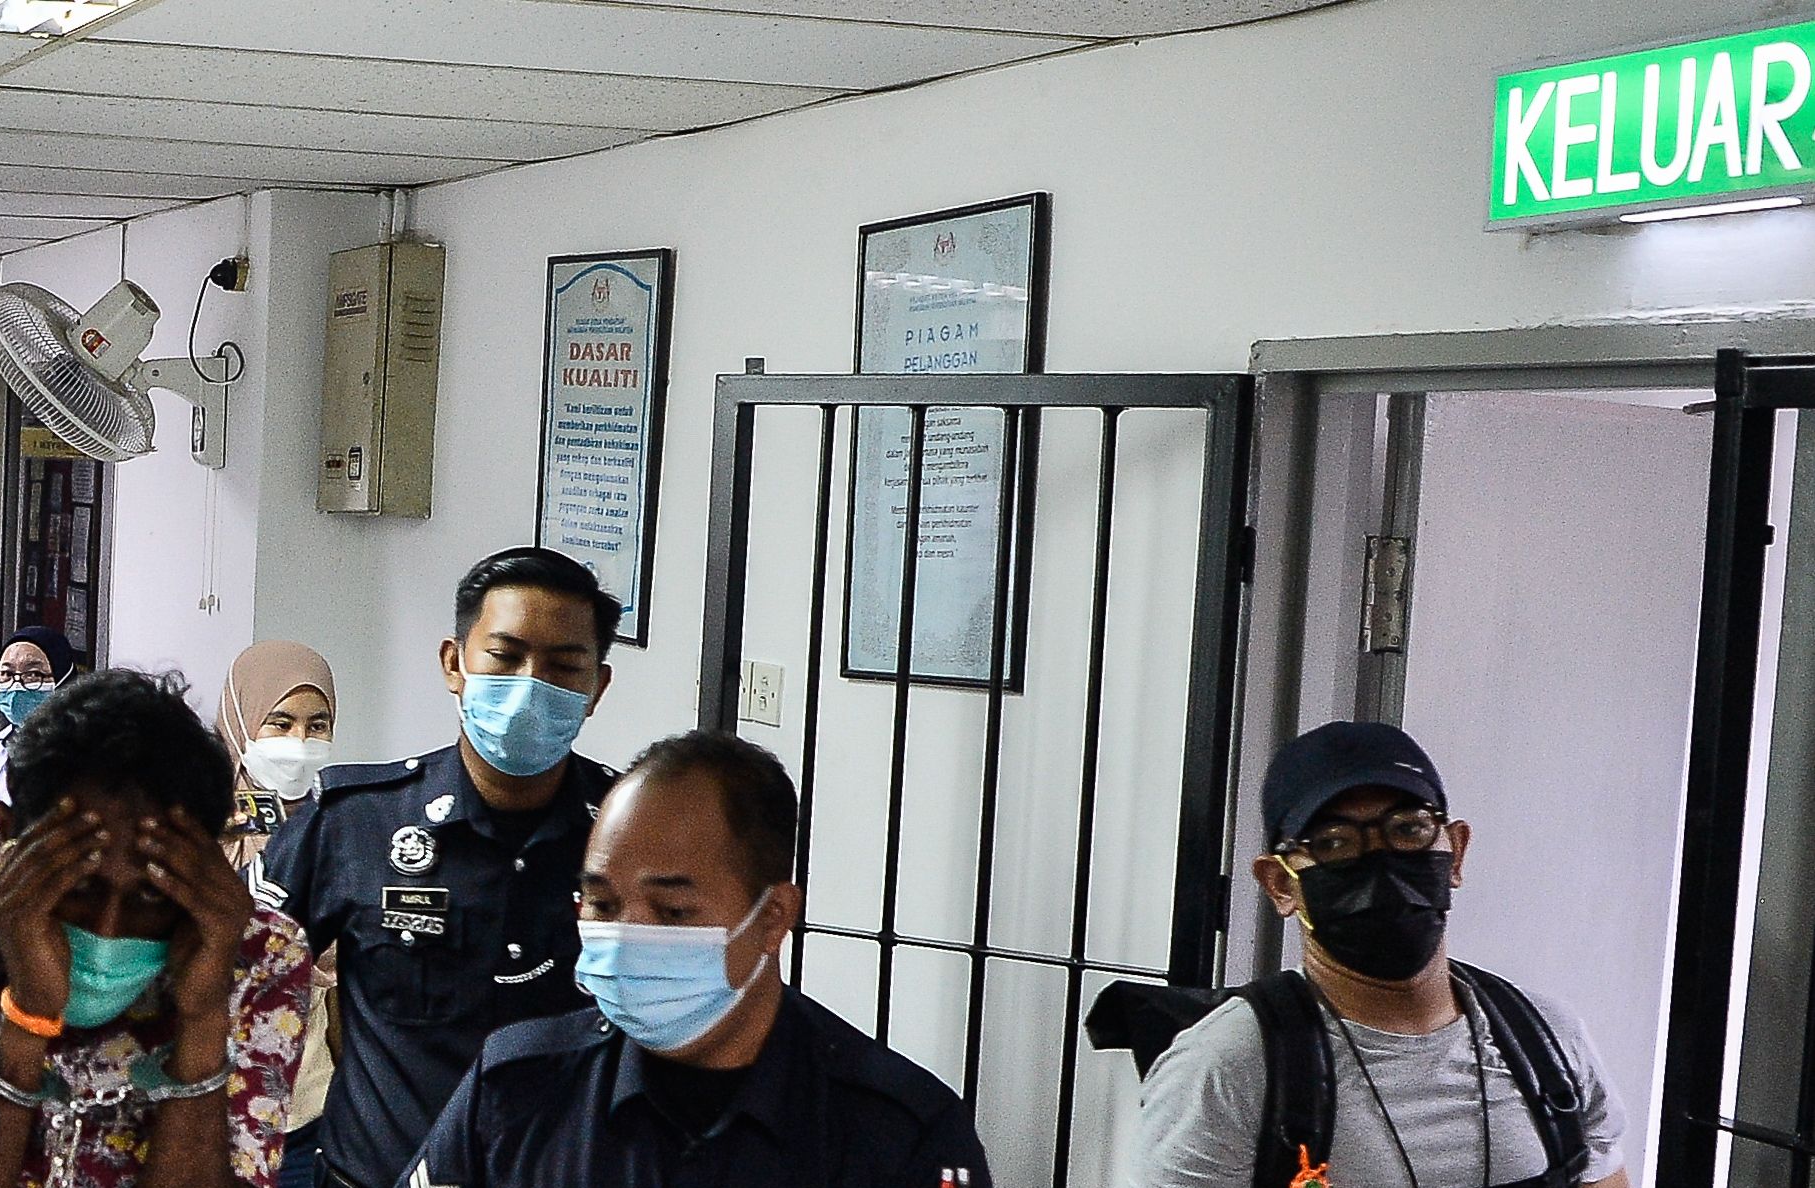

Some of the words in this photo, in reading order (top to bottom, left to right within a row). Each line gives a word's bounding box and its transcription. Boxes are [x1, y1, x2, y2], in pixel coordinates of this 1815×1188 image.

[1503, 41, 1811, 205] KELUAR
[905, 322, 979, 346] PIAGAM
[569, 342, 632, 361] DASAR
[562, 367, 639, 389] KUALITI
